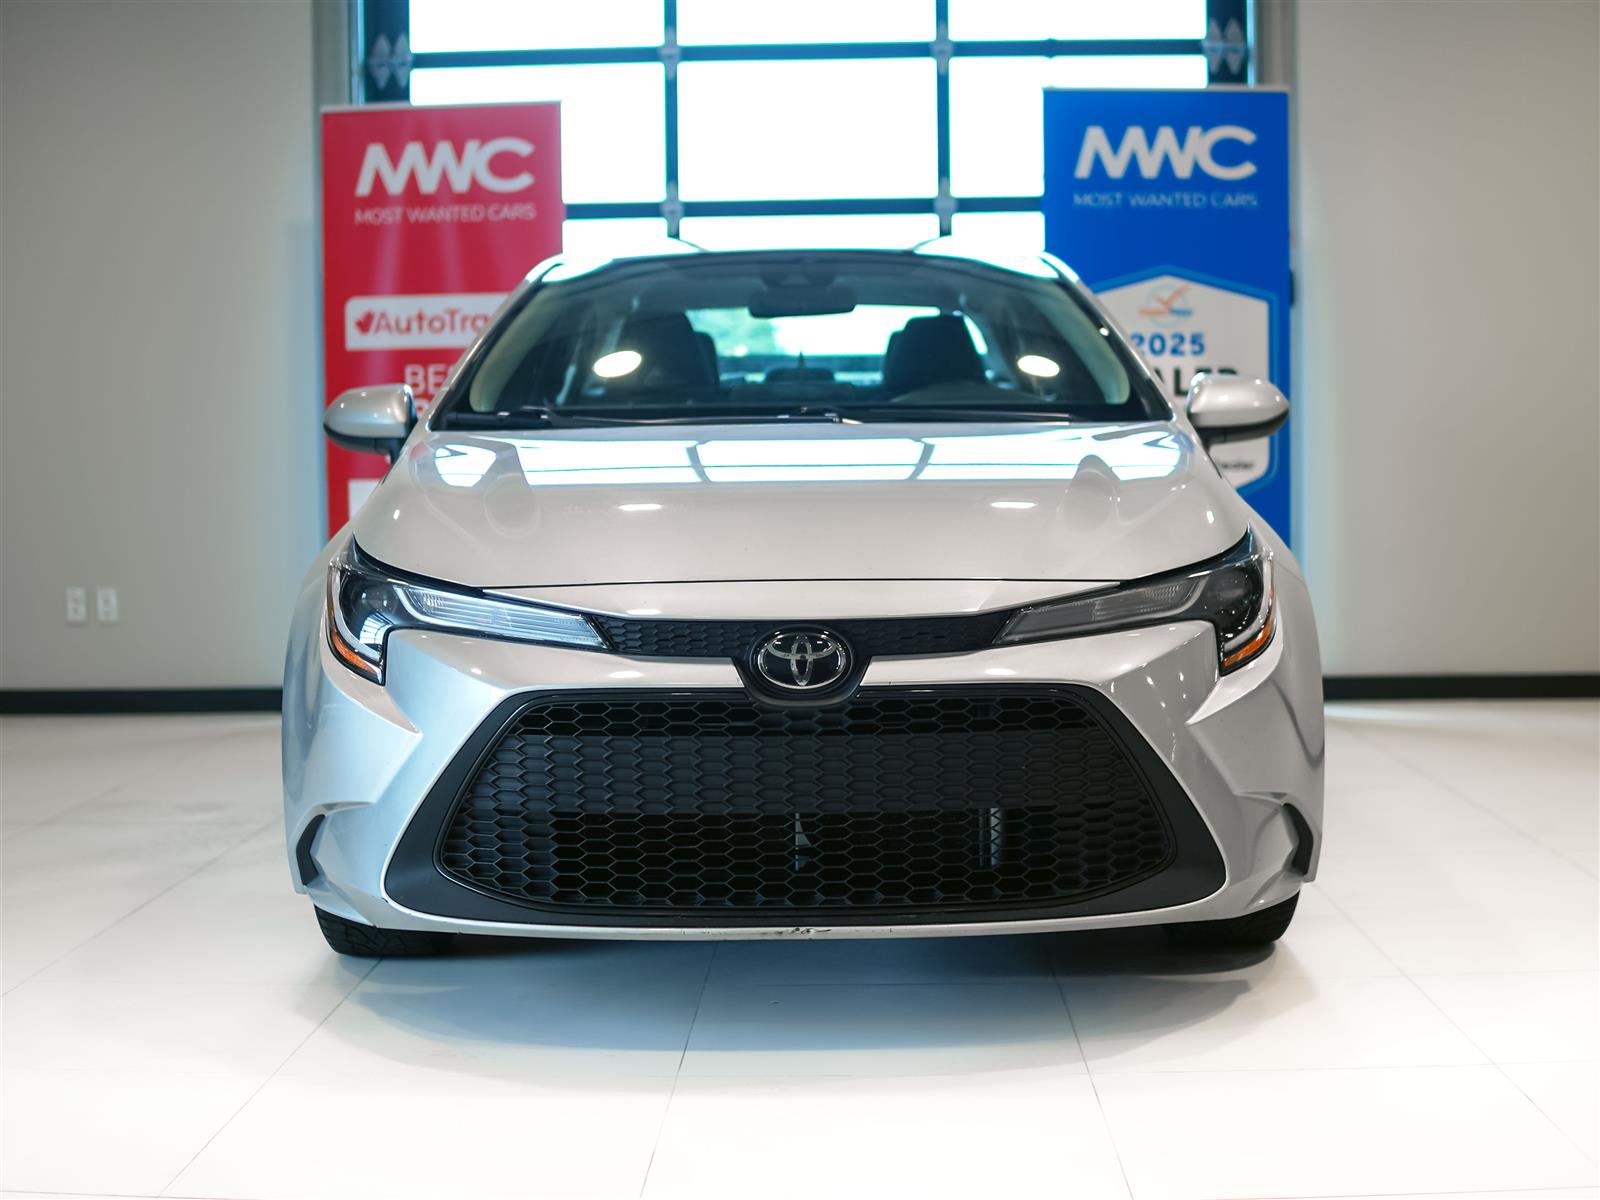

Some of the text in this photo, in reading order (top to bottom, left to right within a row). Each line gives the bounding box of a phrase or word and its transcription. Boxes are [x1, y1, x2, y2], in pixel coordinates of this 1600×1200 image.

[1074, 125, 1257, 180] MWC
[355, 137, 535, 197] MWC
[355, 202, 537, 225] MOST WANTED CARS
[1073, 191, 1259, 208] MOST WANTED CARS
[1130, 332, 1205, 356] 2025
[405, 364, 456, 396] BE
